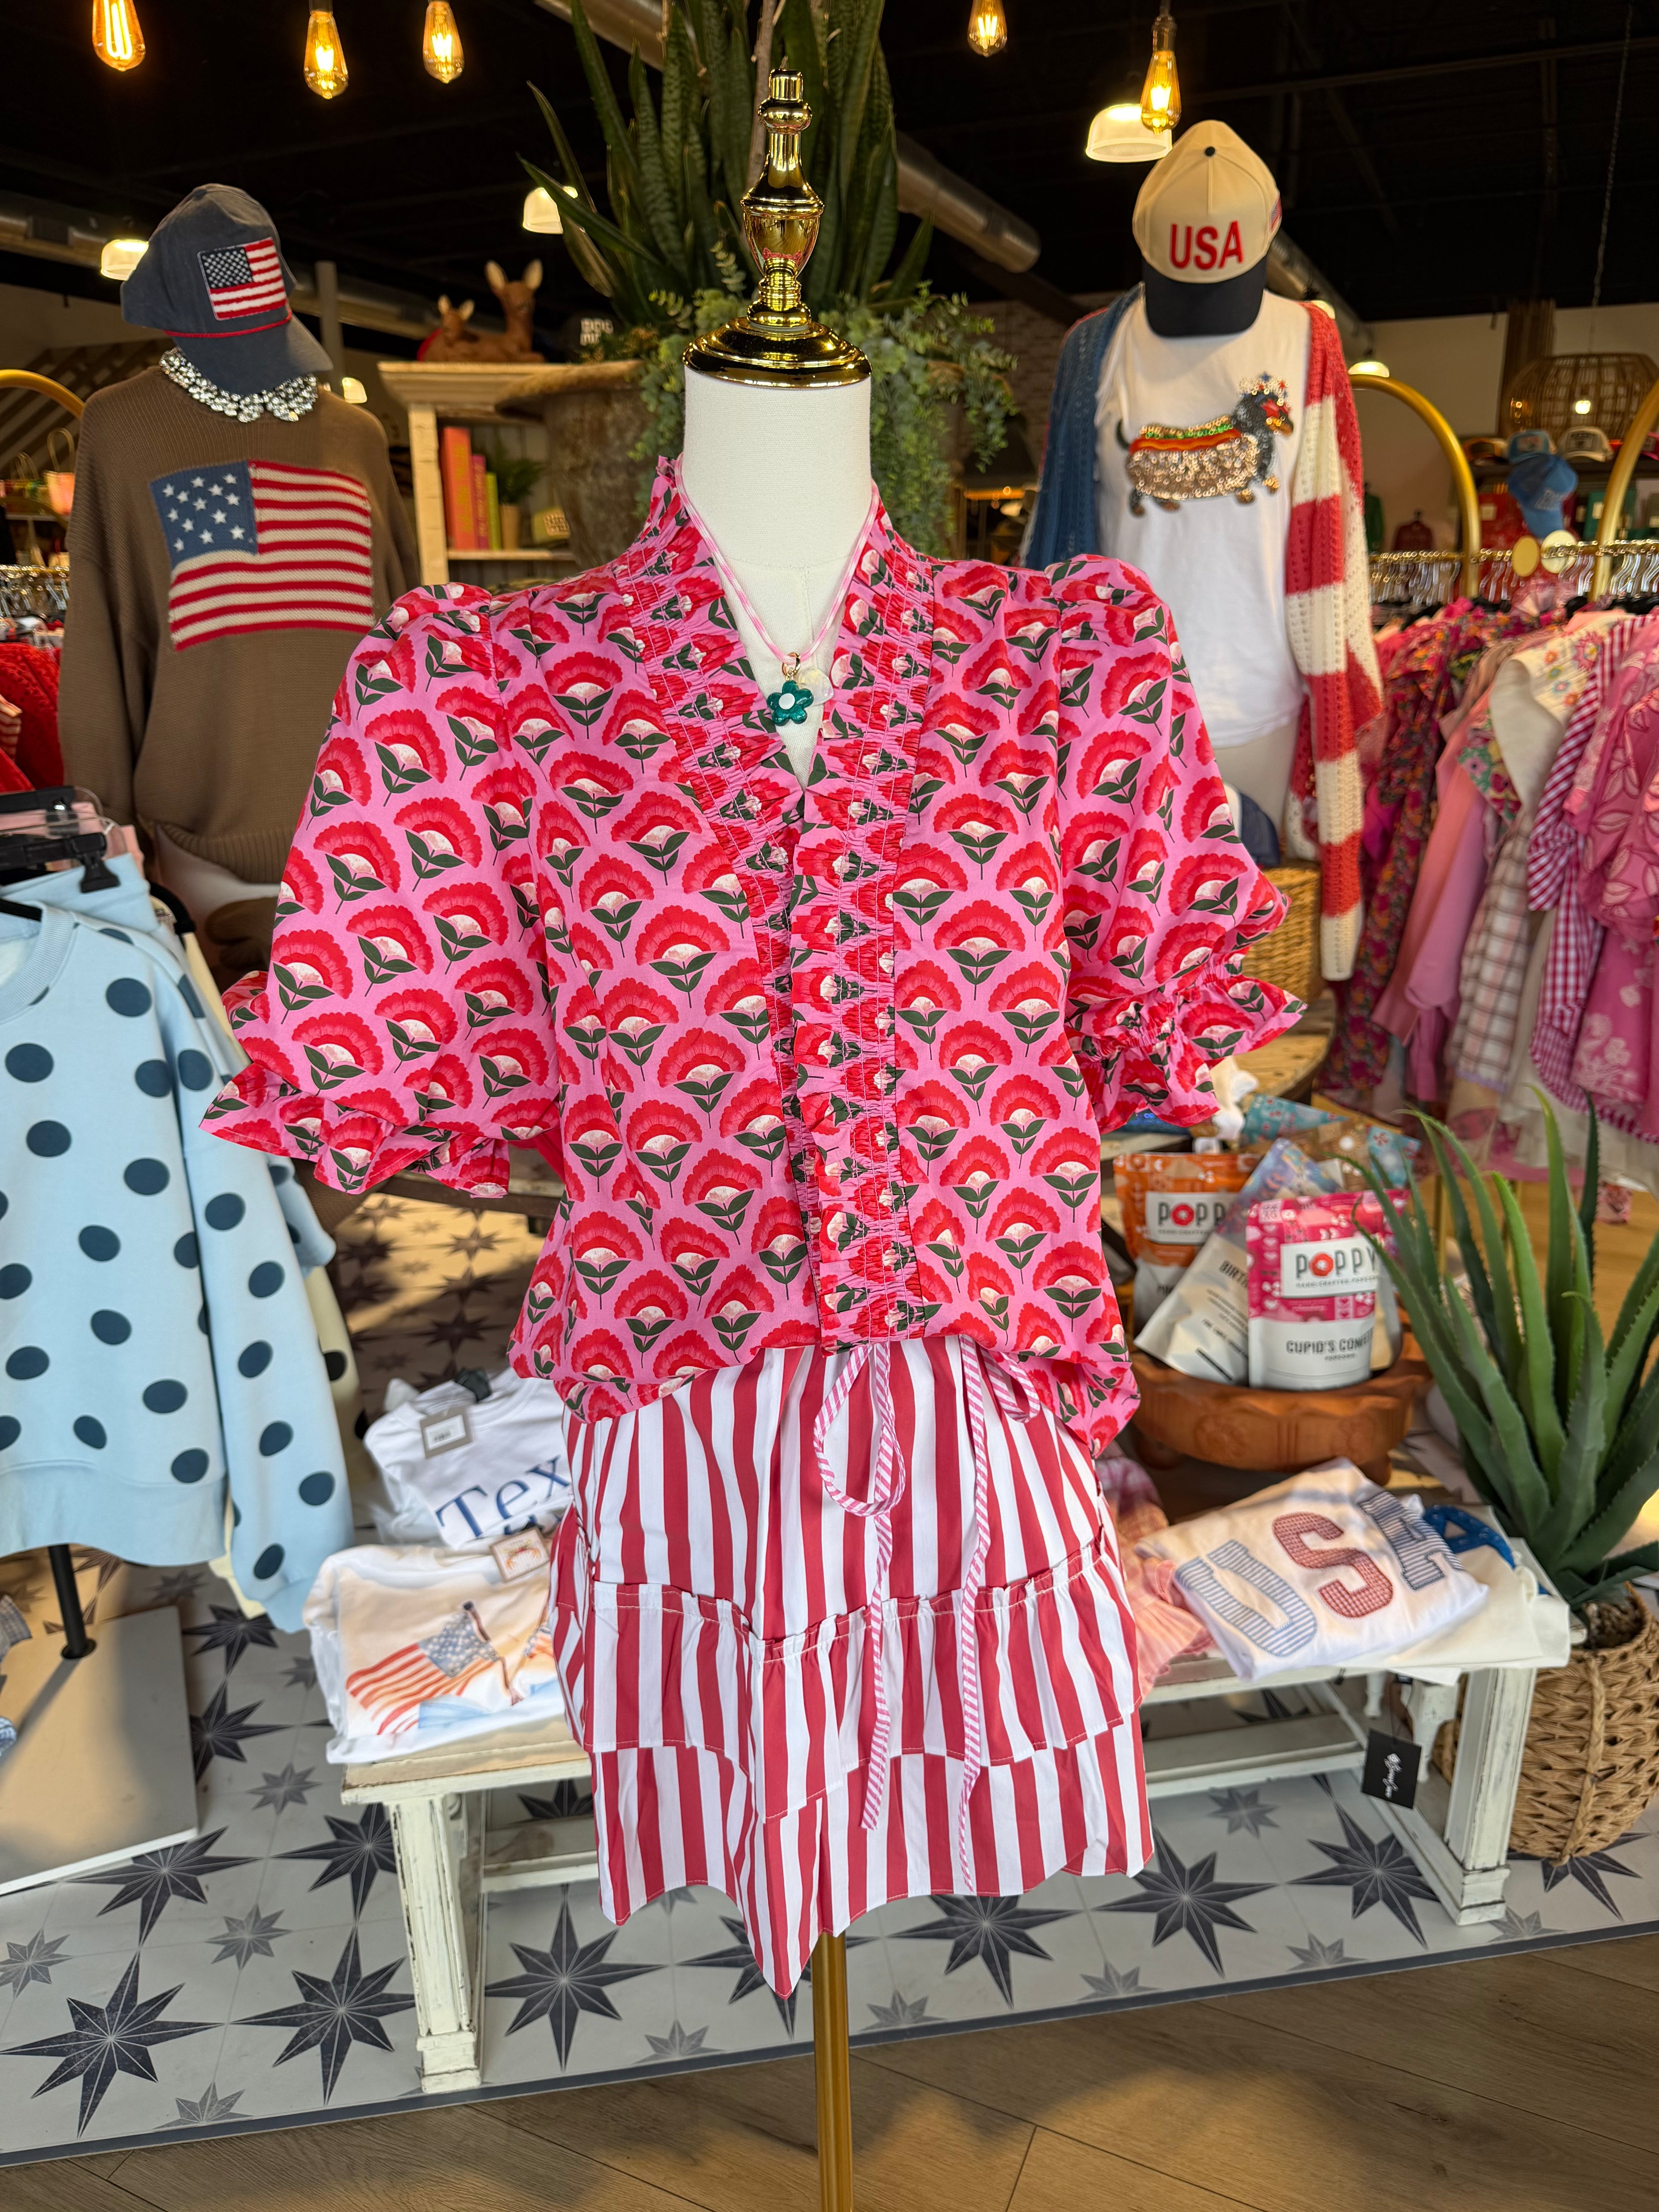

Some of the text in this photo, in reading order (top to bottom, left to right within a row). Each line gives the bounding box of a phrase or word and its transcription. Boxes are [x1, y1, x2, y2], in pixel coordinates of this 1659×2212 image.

[1170, 220, 1243, 270] USA
[1296, 1246, 1376, 1279] POPPY
[1286, 1340, 1335, 1354] CUPID'S
[1175, 1491, 1465, 1657] USA
